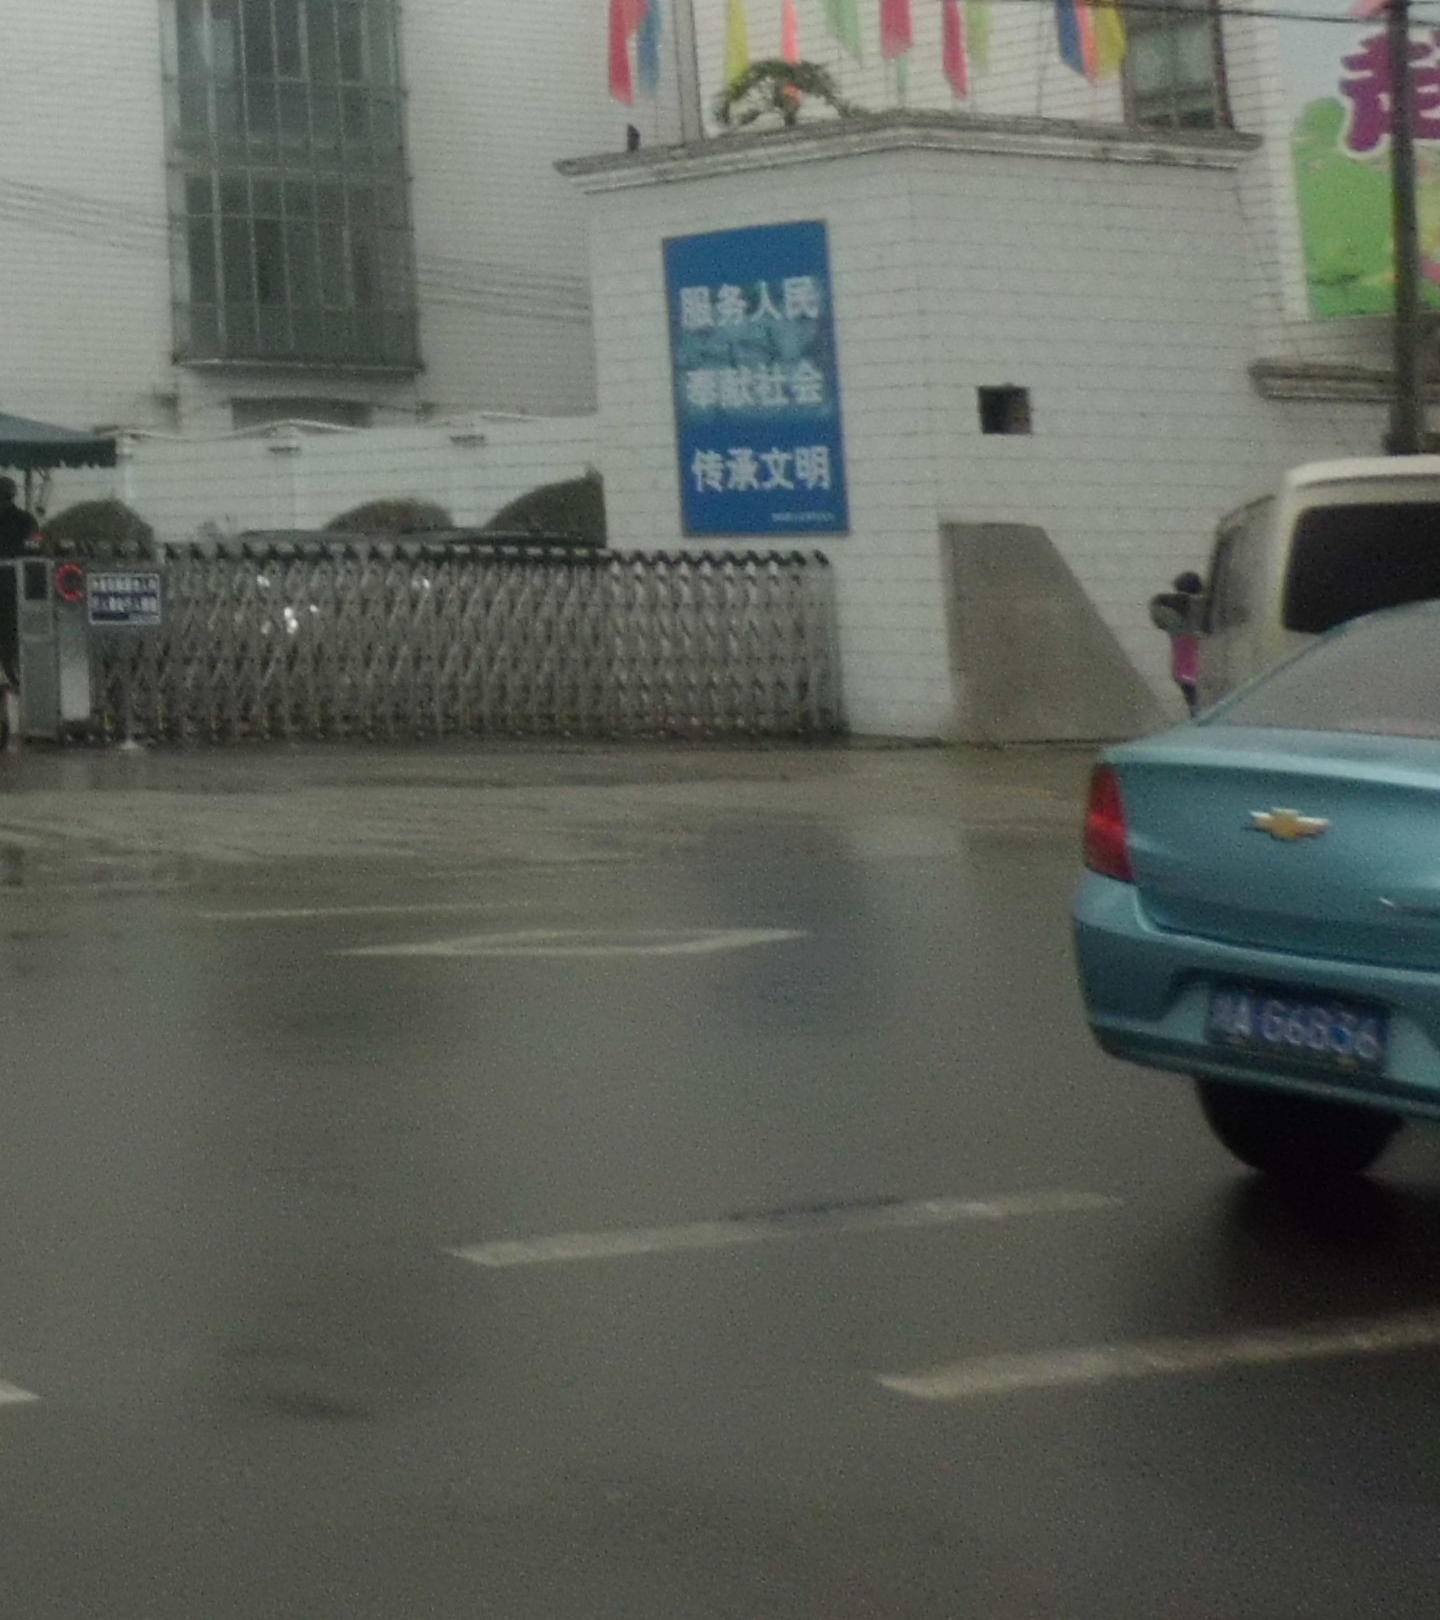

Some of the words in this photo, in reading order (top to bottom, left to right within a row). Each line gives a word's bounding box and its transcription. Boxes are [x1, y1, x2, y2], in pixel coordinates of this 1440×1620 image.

[679, 276, 819, 330] 服务人民
[685, 359, 823, 409] 奉献社会
[690, 445, 832, 493] 传承文明
